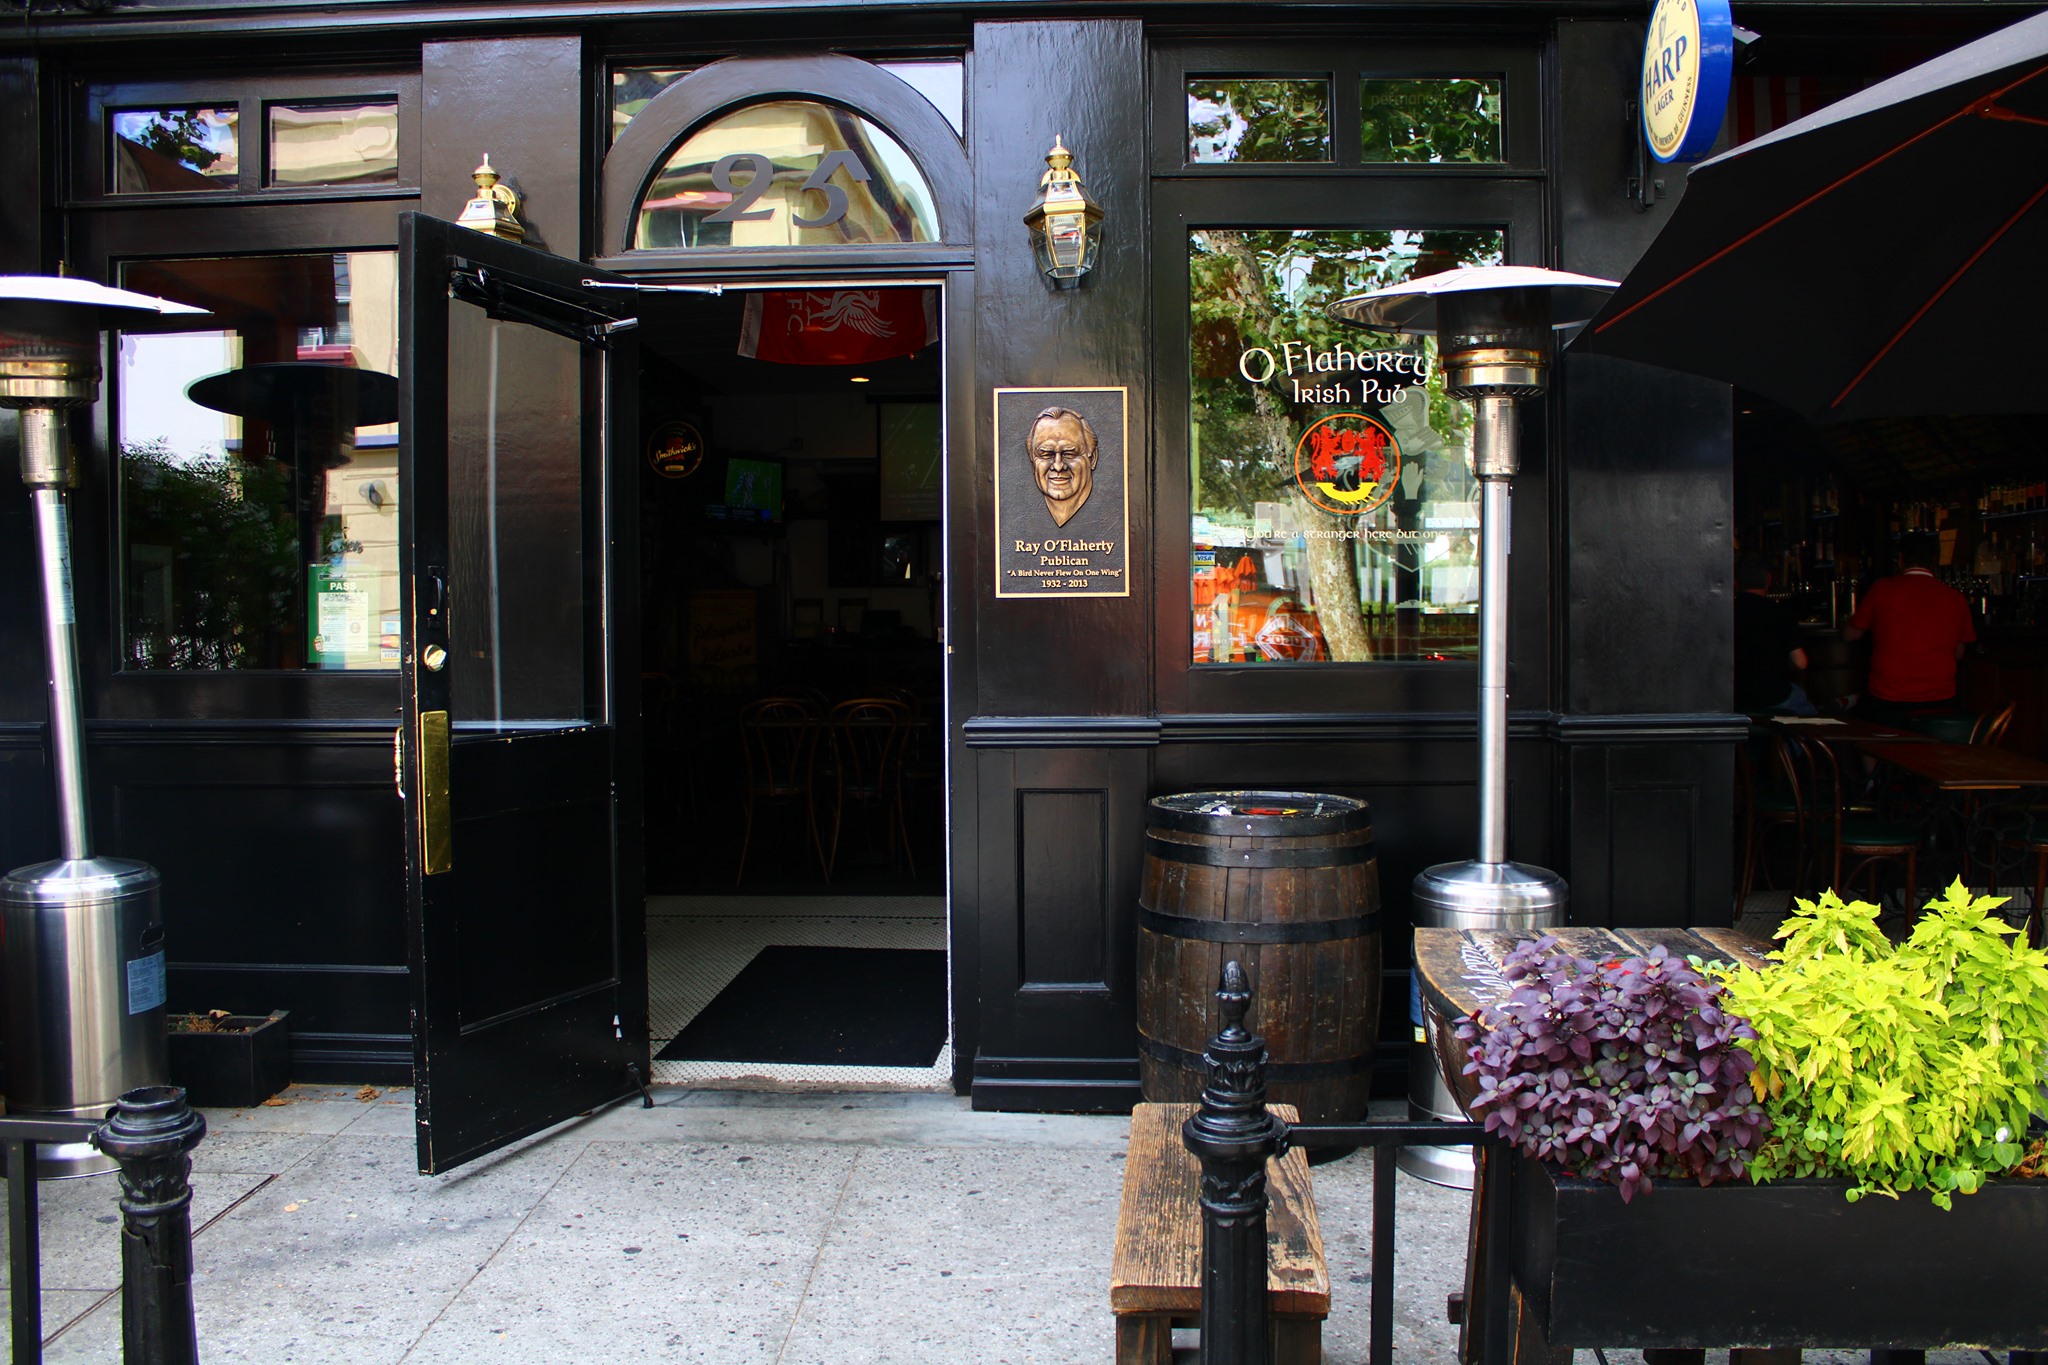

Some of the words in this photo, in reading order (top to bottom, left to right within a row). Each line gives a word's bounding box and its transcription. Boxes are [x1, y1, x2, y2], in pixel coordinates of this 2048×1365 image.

[1644, 35, 1688, 104] HARP
[1654, 88, 1674, 116] LAGER
[1677, 75, 1693, 123] GUINNESS
[701, 149, 872, 228] 25
[1239, 340, 1434, 386] O'Flaherty
[1292, 378, 1351, 404] Irish
[1360, 378, 1408, 404] Pub
[653, 441, 697, 464] Smithwick's
[1291, 530, 1299, 539] a
[1303, 530, 1360, 542] stranger
[1364, 528, 1393, 539] here
[1397, 528, 1420, 539] but
[1015, 540, 1041, 556] Ray
[1043, 539, 1115, 555] O'Flaherty
[1040, 555, 1089, 566] Publican
[330, 582, 357, 591] PASS
[1041, 580, 1062, 588] 1932
[1068, 579, 1089, 588] 2013
